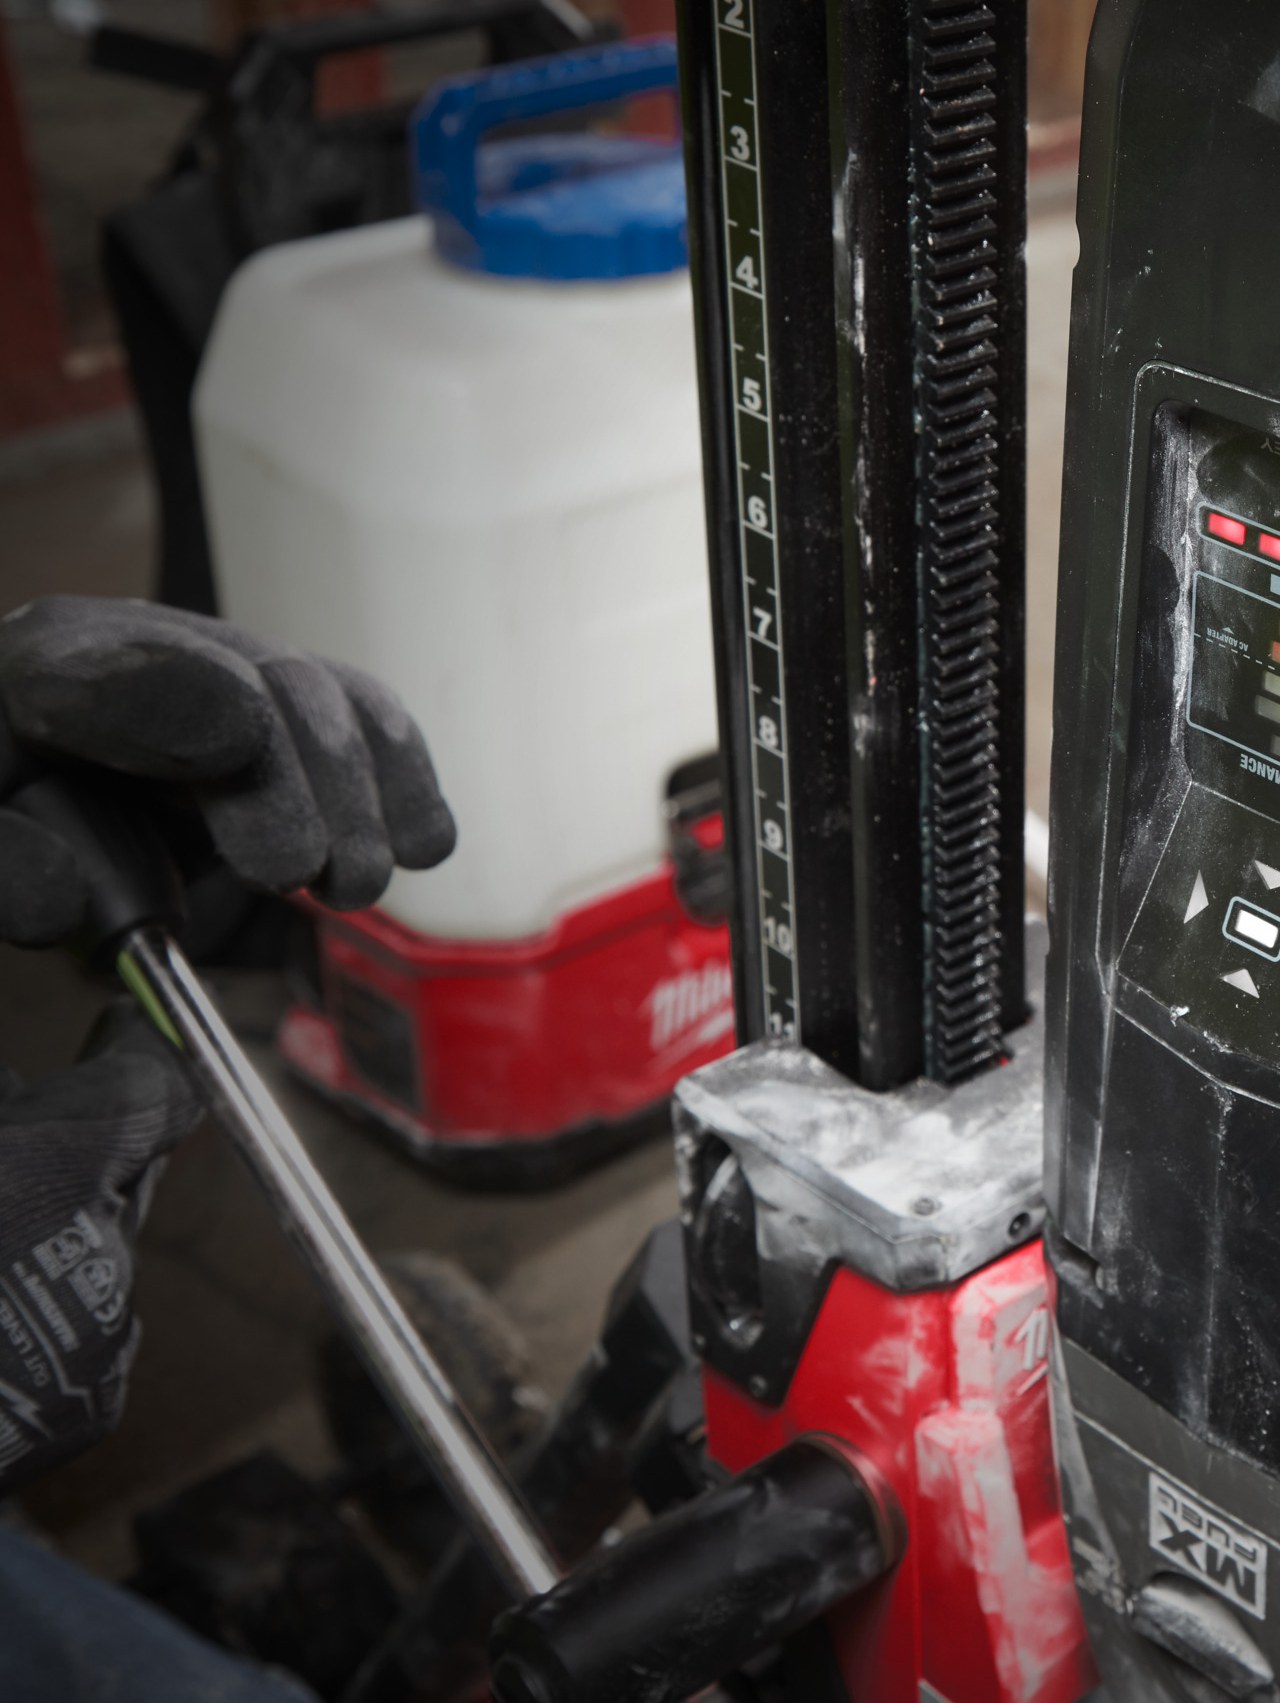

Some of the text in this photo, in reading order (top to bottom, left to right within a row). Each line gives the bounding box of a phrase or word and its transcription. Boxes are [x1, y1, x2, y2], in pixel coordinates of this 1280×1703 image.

[724, 0, 744, 29] 2
[730, 125, 750, 161] 3
[735, 256, 758, 289] 4
[743, 378, 761, 410] 5
[748, 496, 767, 530] 6
[753, 607, 773, 638] 7
[1207, 627, 1249, 651] AC ADAPTER
[759, 716, 778, 748] 8
[763, 820, 783, 851] 9
[765, 918, 791, 951] 10
[1157, 1484, 1257, 1564] FUEL
[1161, 1508, 1256, 1610] MX
